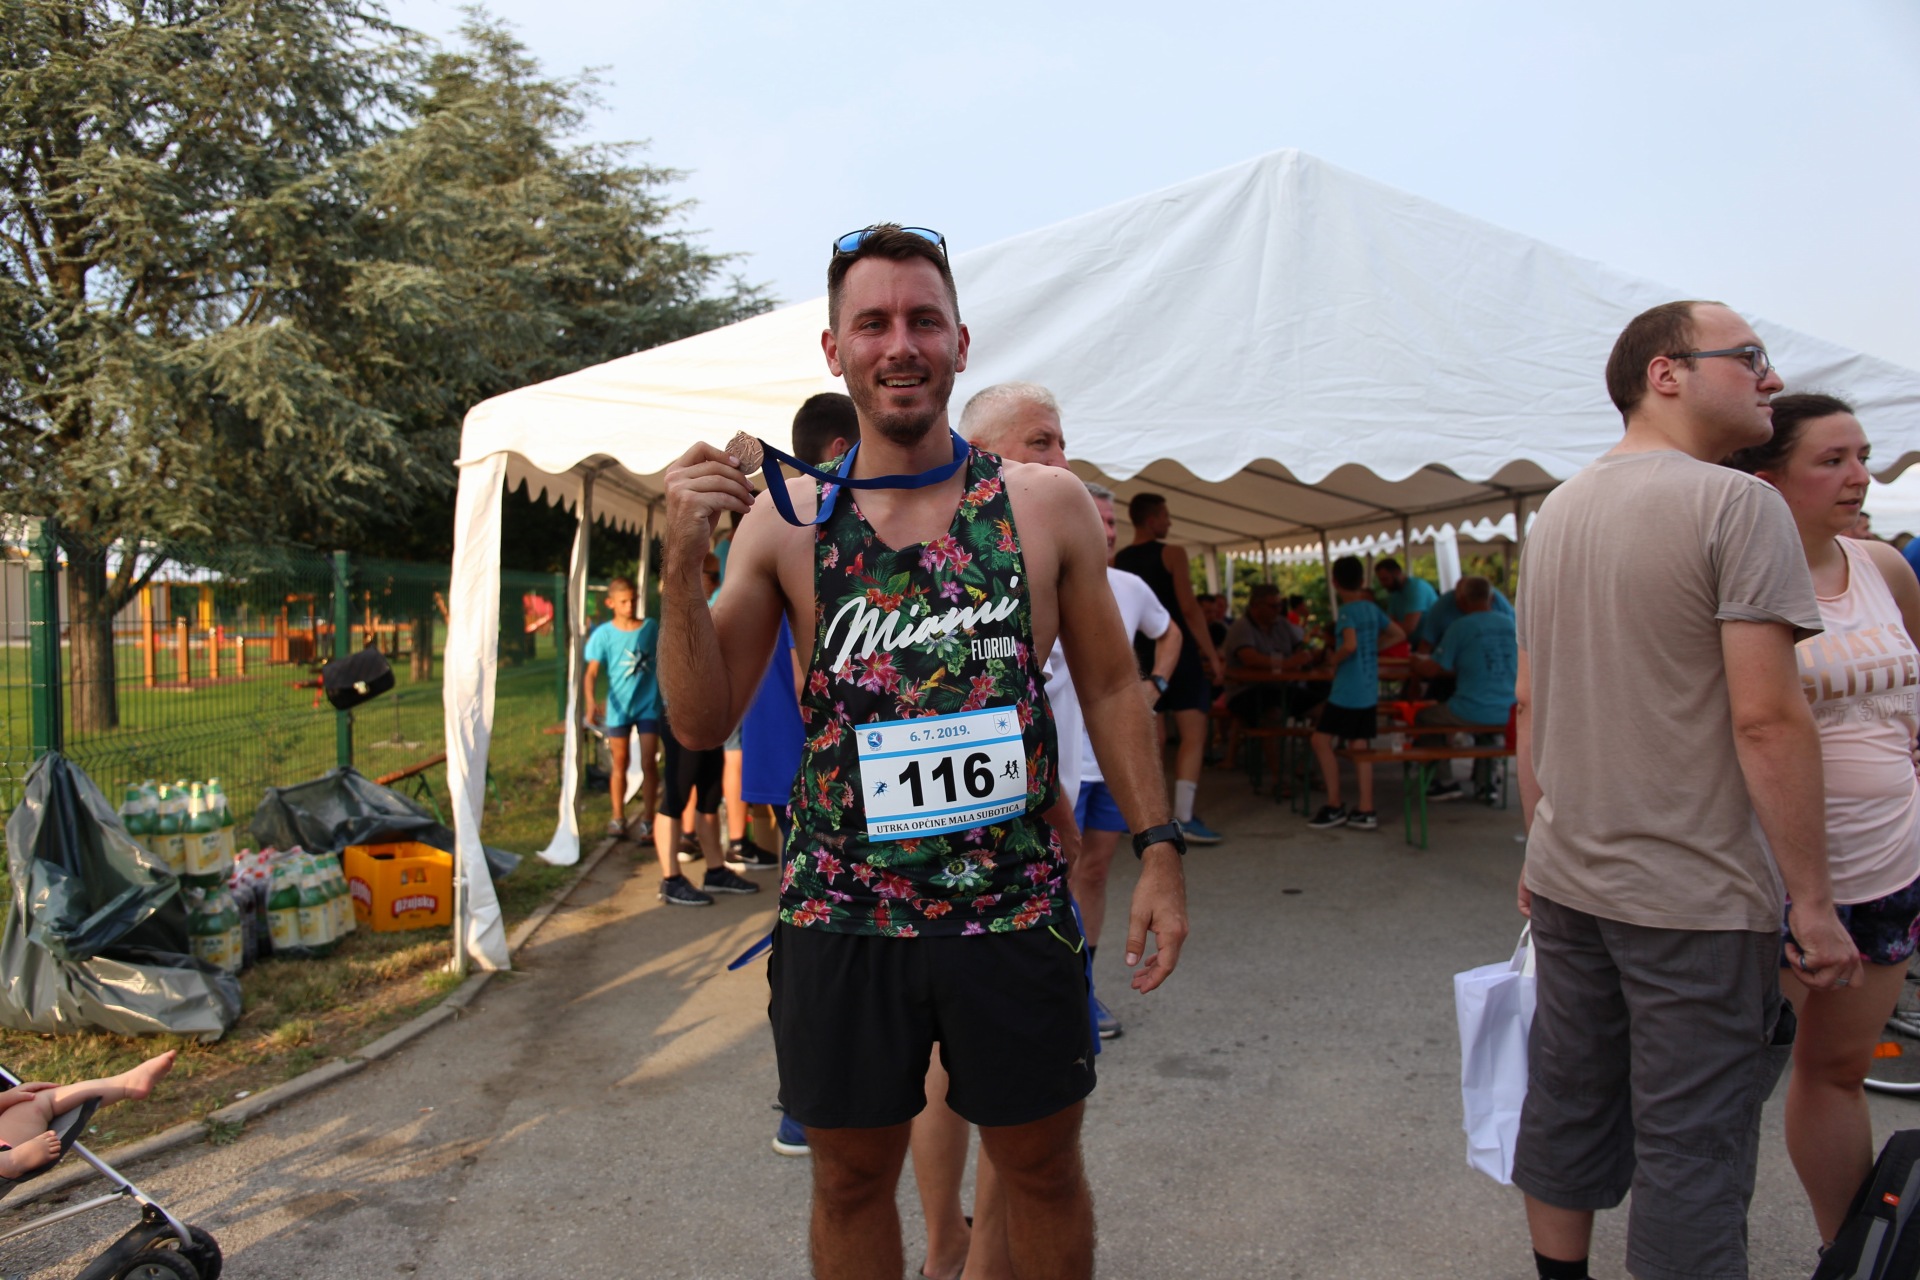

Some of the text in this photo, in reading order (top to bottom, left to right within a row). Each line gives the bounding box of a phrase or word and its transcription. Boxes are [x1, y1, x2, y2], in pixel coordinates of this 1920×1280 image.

[824, 576, 1019, 673] Miami
[971, 635, 1018, 661] FLORIDA
[1800, 653, 1920, 705] GLITTE
[1859, 692, 1920, 721] SWE
[909, 724, 970, 742] 6. 7. 2019.
[898, 752, 995, 807] 116
[876, 804, 1020, 834] UTRKA OPĆINE MALA SUBOTICA
